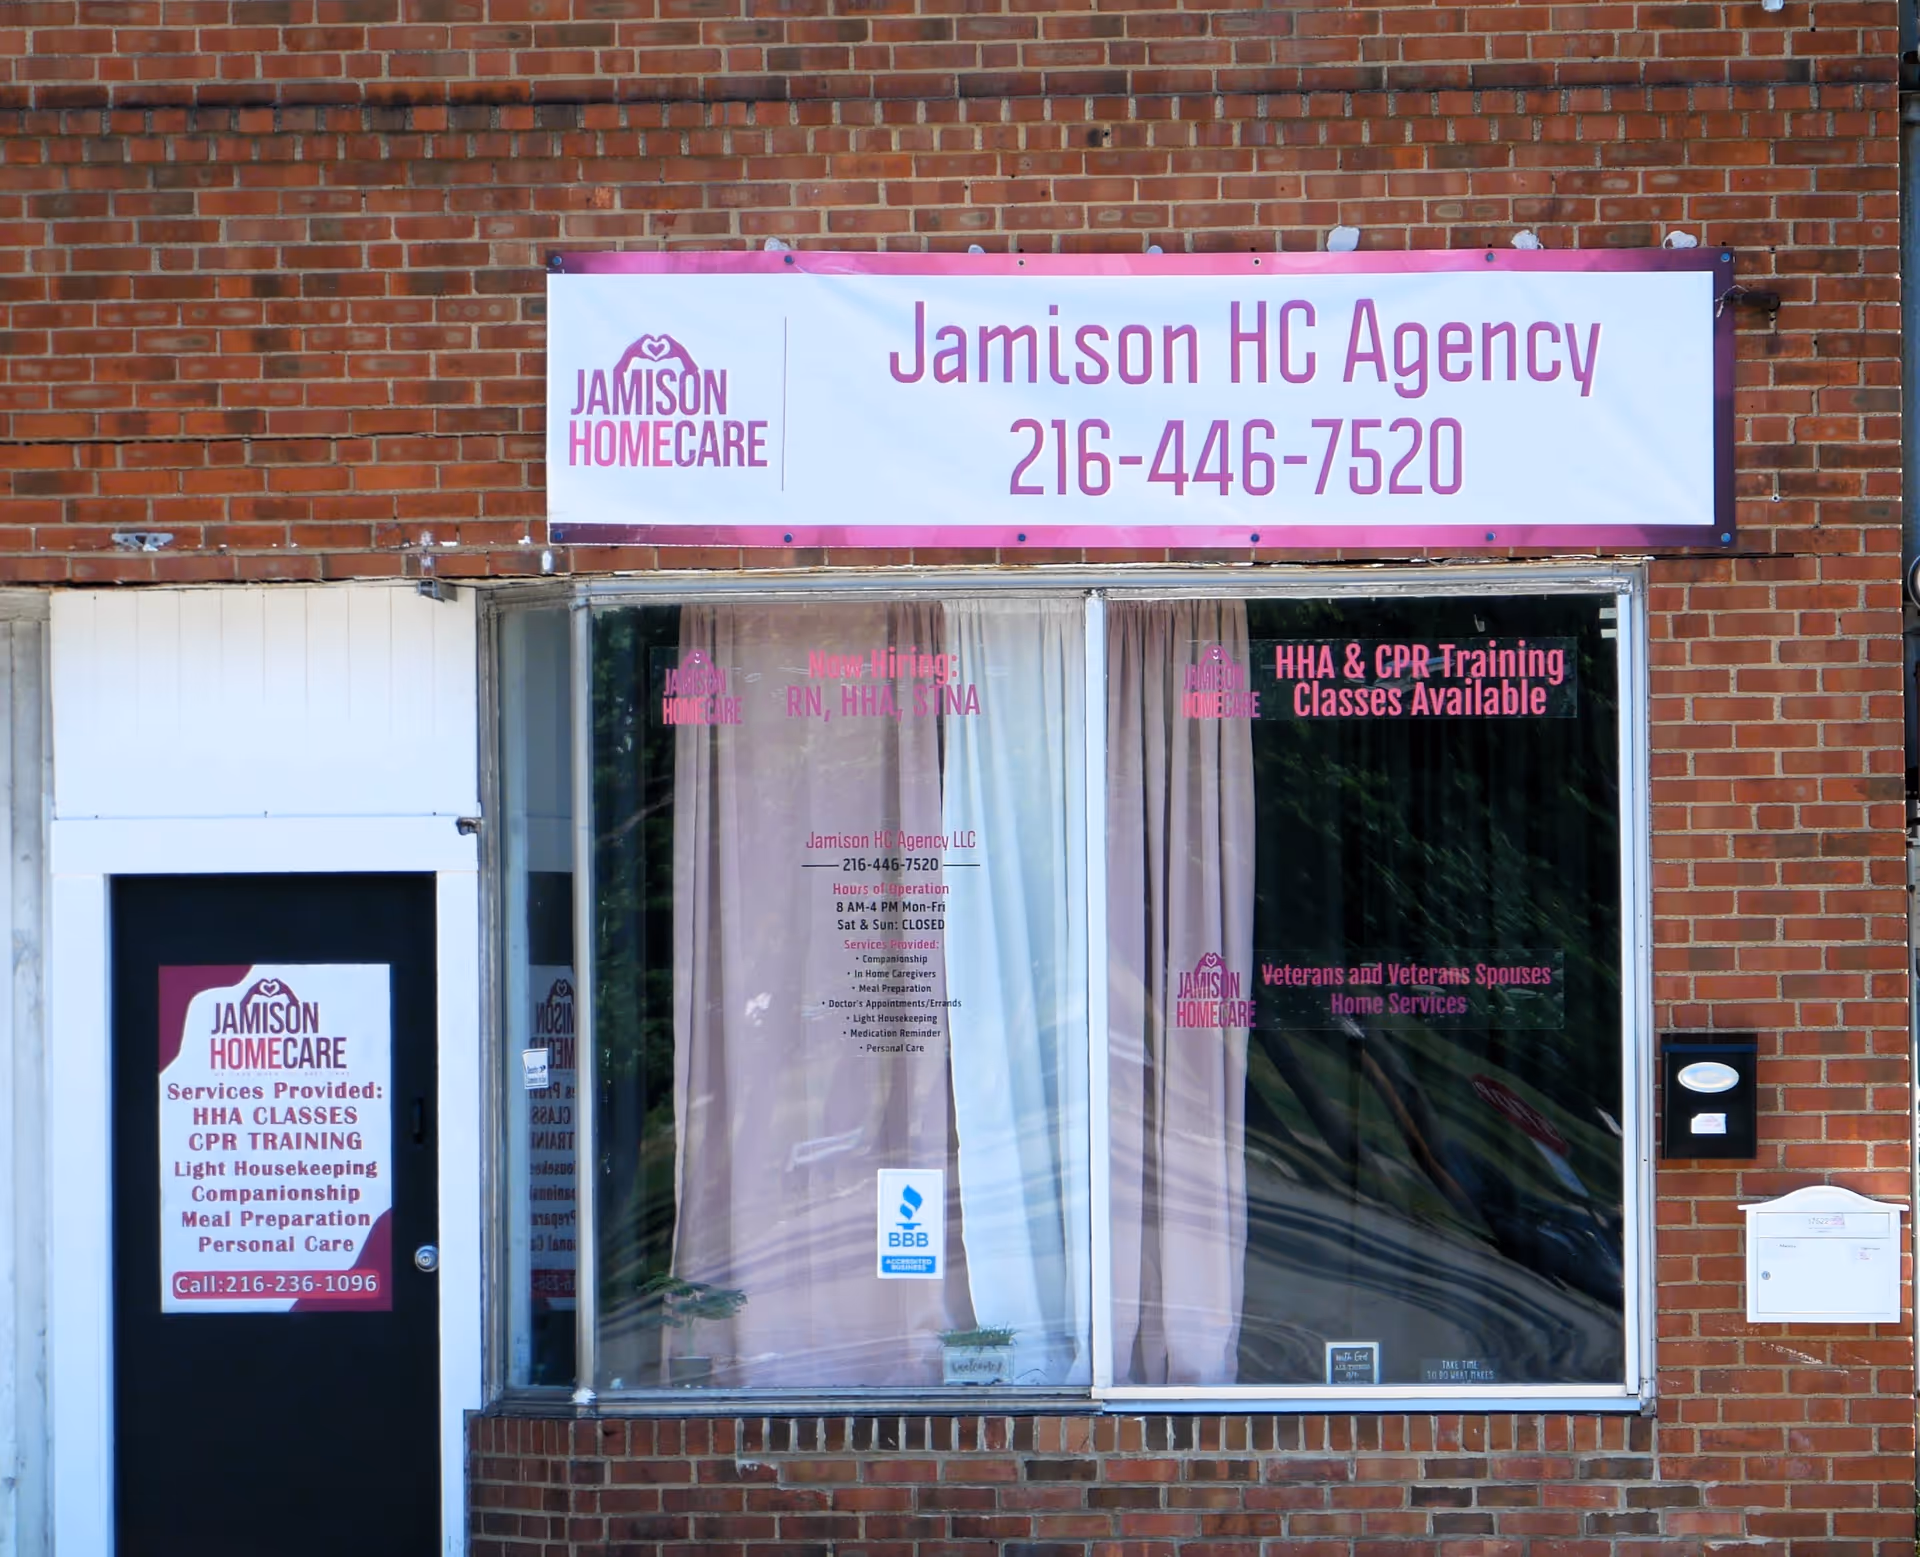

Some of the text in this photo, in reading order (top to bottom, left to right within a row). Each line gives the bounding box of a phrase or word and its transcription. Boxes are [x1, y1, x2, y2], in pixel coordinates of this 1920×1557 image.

[889, 298, 1601, 399] Jamison HC Agency
[570, 369, 728, 416] JAMISON
[568, 420, 769, 468] HOMECARE
[1009, 416, 1463, 497] 216-446-7520
[807, 646, 959, 685] Now Hiring:
[1275, 639, 1565, 686] HHA & CPR Training
[663, 668, 727, 695] JAMISON
[1182, 664, 1244, 691] JAMISON
[786, 684, 981, 723] RN, HHA, STNA
[1181, 691, 1262, 719] HOMECARE
[1293, 678, 1548, 718] Classes Available
[662, 697, 743, 725] HOMECARE
[805, 830, 976, 851] Jamison HC Agency LLC
[842, 857, 939, 872] 216-446-7520
[832, 882, 950, 897] Hours of Operation
[836, 901, 946, 912] 8 AM-4 PM Mon-Fri
[837, 919, 945, 931] Sat & Sun: CLOSED
[844, 939, 940, 950] Services Provided:
[862, 954, 928, 965] Companionship
[854, 969, 936, 980] In Home Caregivers
[1261, 963, 1551, 990] Veterans and Veterans Spouses
[858, 984, 932, 995] Meal Preparation
[1176, 972, 1241, 999] JAMISON
[828, 999, 863, 1009] Doctor's
[1176, 1000, 1257, 1028] HOMECARE
[1330, 992, 1468, 1015] Home Services
[210, 1002, 319, 1035] JAMISON
[853, 1014, 938, 1025] Light Housekeeping
[850, 1028, 941, 1038] Medication Reminder
[209, 1036, 348, 1070] HOMECARE
[866, 1043, 925, 1052] Personal Care
[167, 1080, 384, 1101] Services Provided:
[192, 1105, 358, 1126] HHA CLASSES
[188, 1131, 364, 1152] CPR TRAINING
[174, 1159, 379, 1179] Light Housekeeping
[191, 1185, 361, 1205] Companionship
[181, 1209, 371, 1230] Meal Preparation
[198, 1235, 354, 1253] Personal Care
[888, 1231, 930, 1248] BBB
[175, 1273, 378, 1295] Call:216-236-1096
[1442, 1360, 1459, 1370] TAKE
